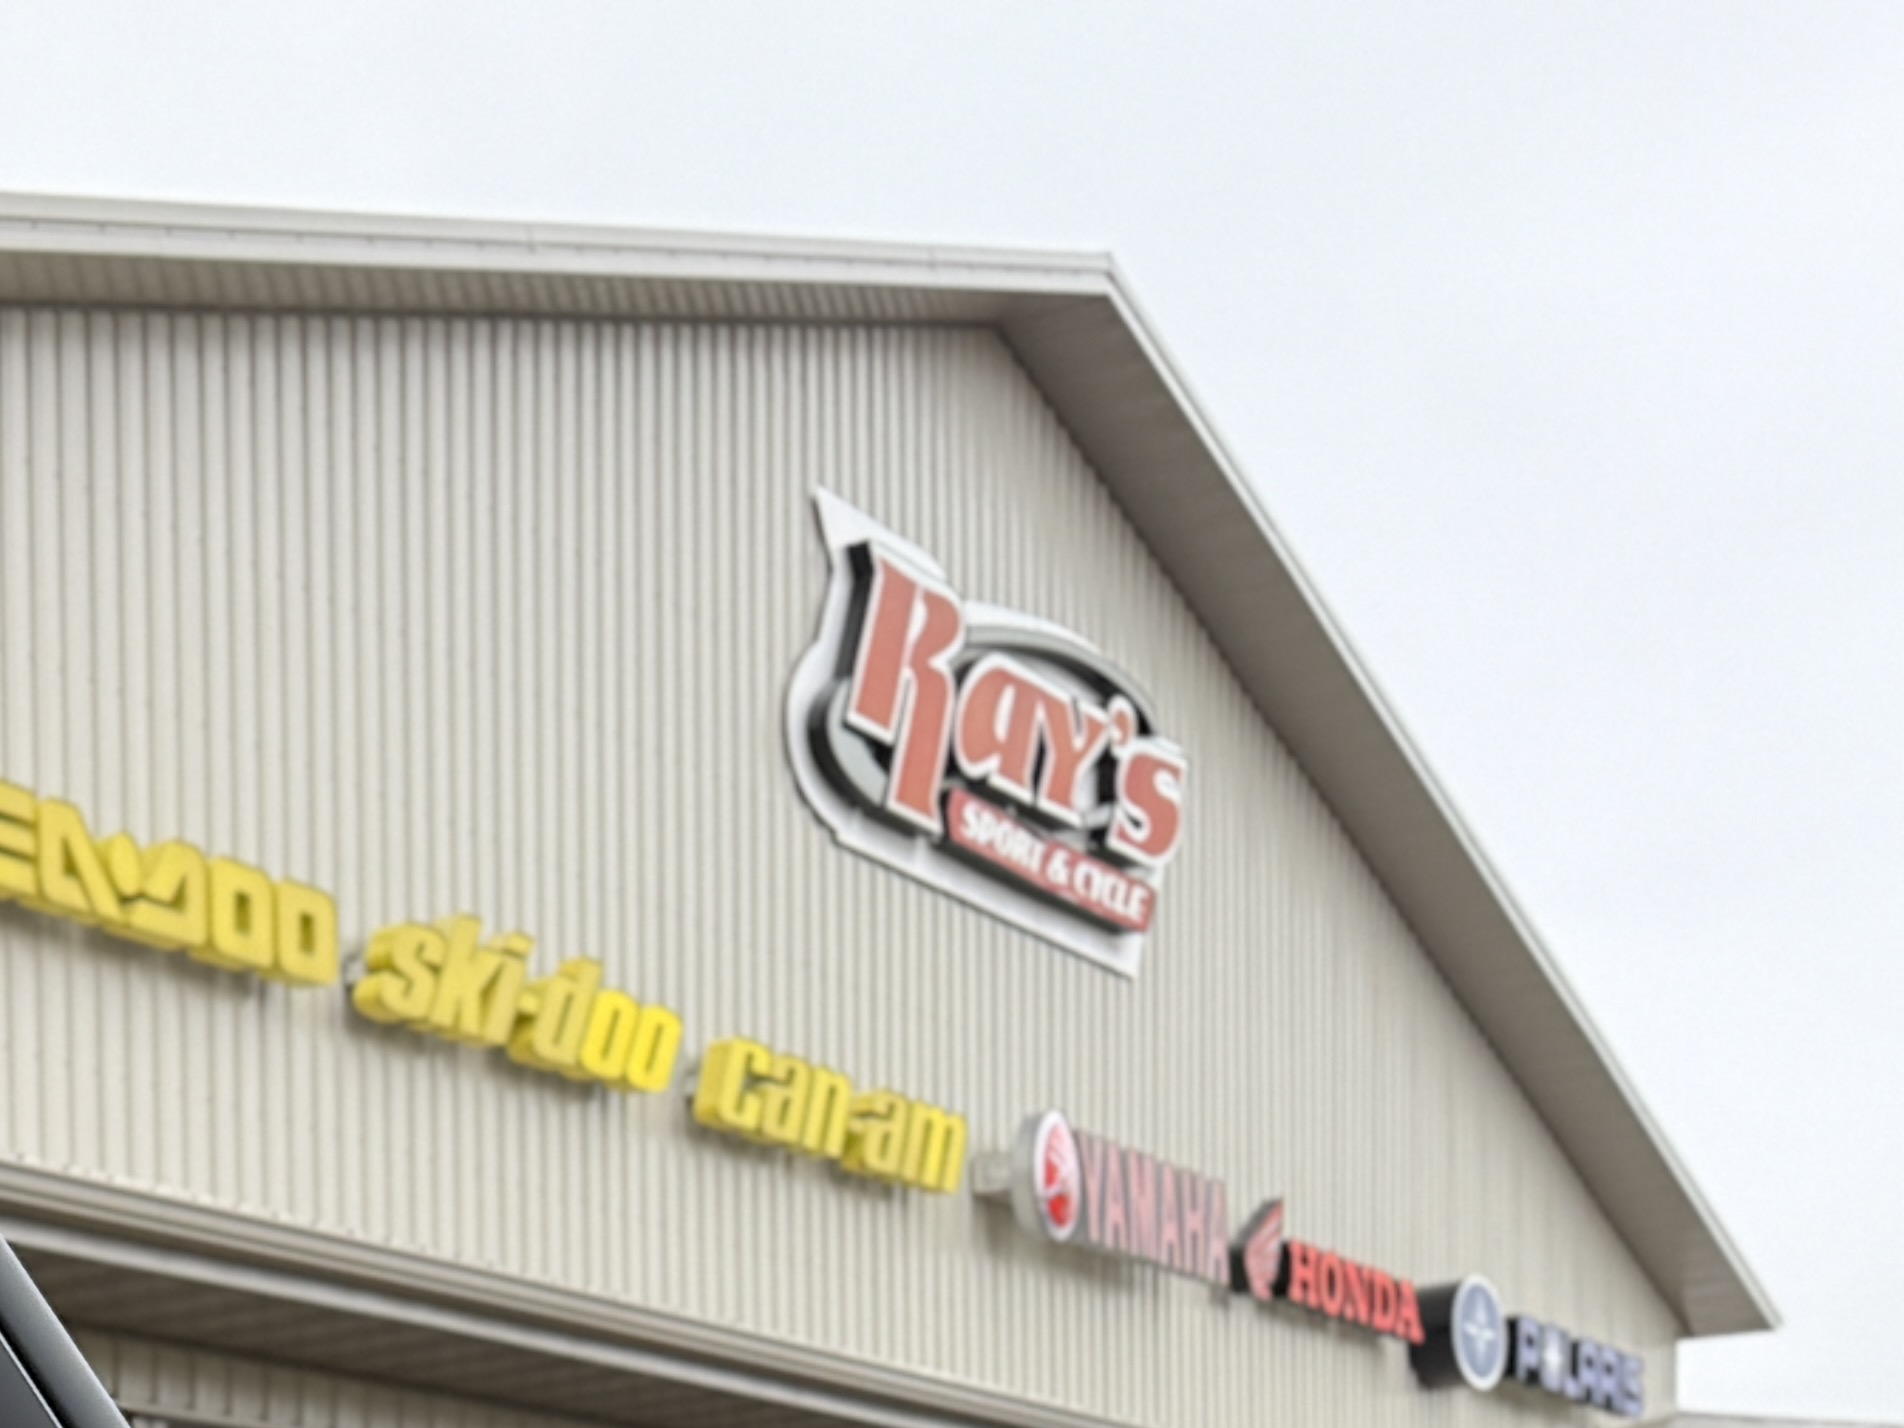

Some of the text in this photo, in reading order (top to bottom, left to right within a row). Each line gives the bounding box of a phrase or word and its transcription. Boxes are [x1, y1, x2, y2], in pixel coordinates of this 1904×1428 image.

[849, 553, 1186, 866] Ray's
[960, 799, 1151, 921] SPORT & CYCLE
[1078, 1130, 1230, 1285] YAMAHA
[1289, 1241, 1425, 1345] HONDA
[1516, 1316, 1644, 1417] POLARIS
